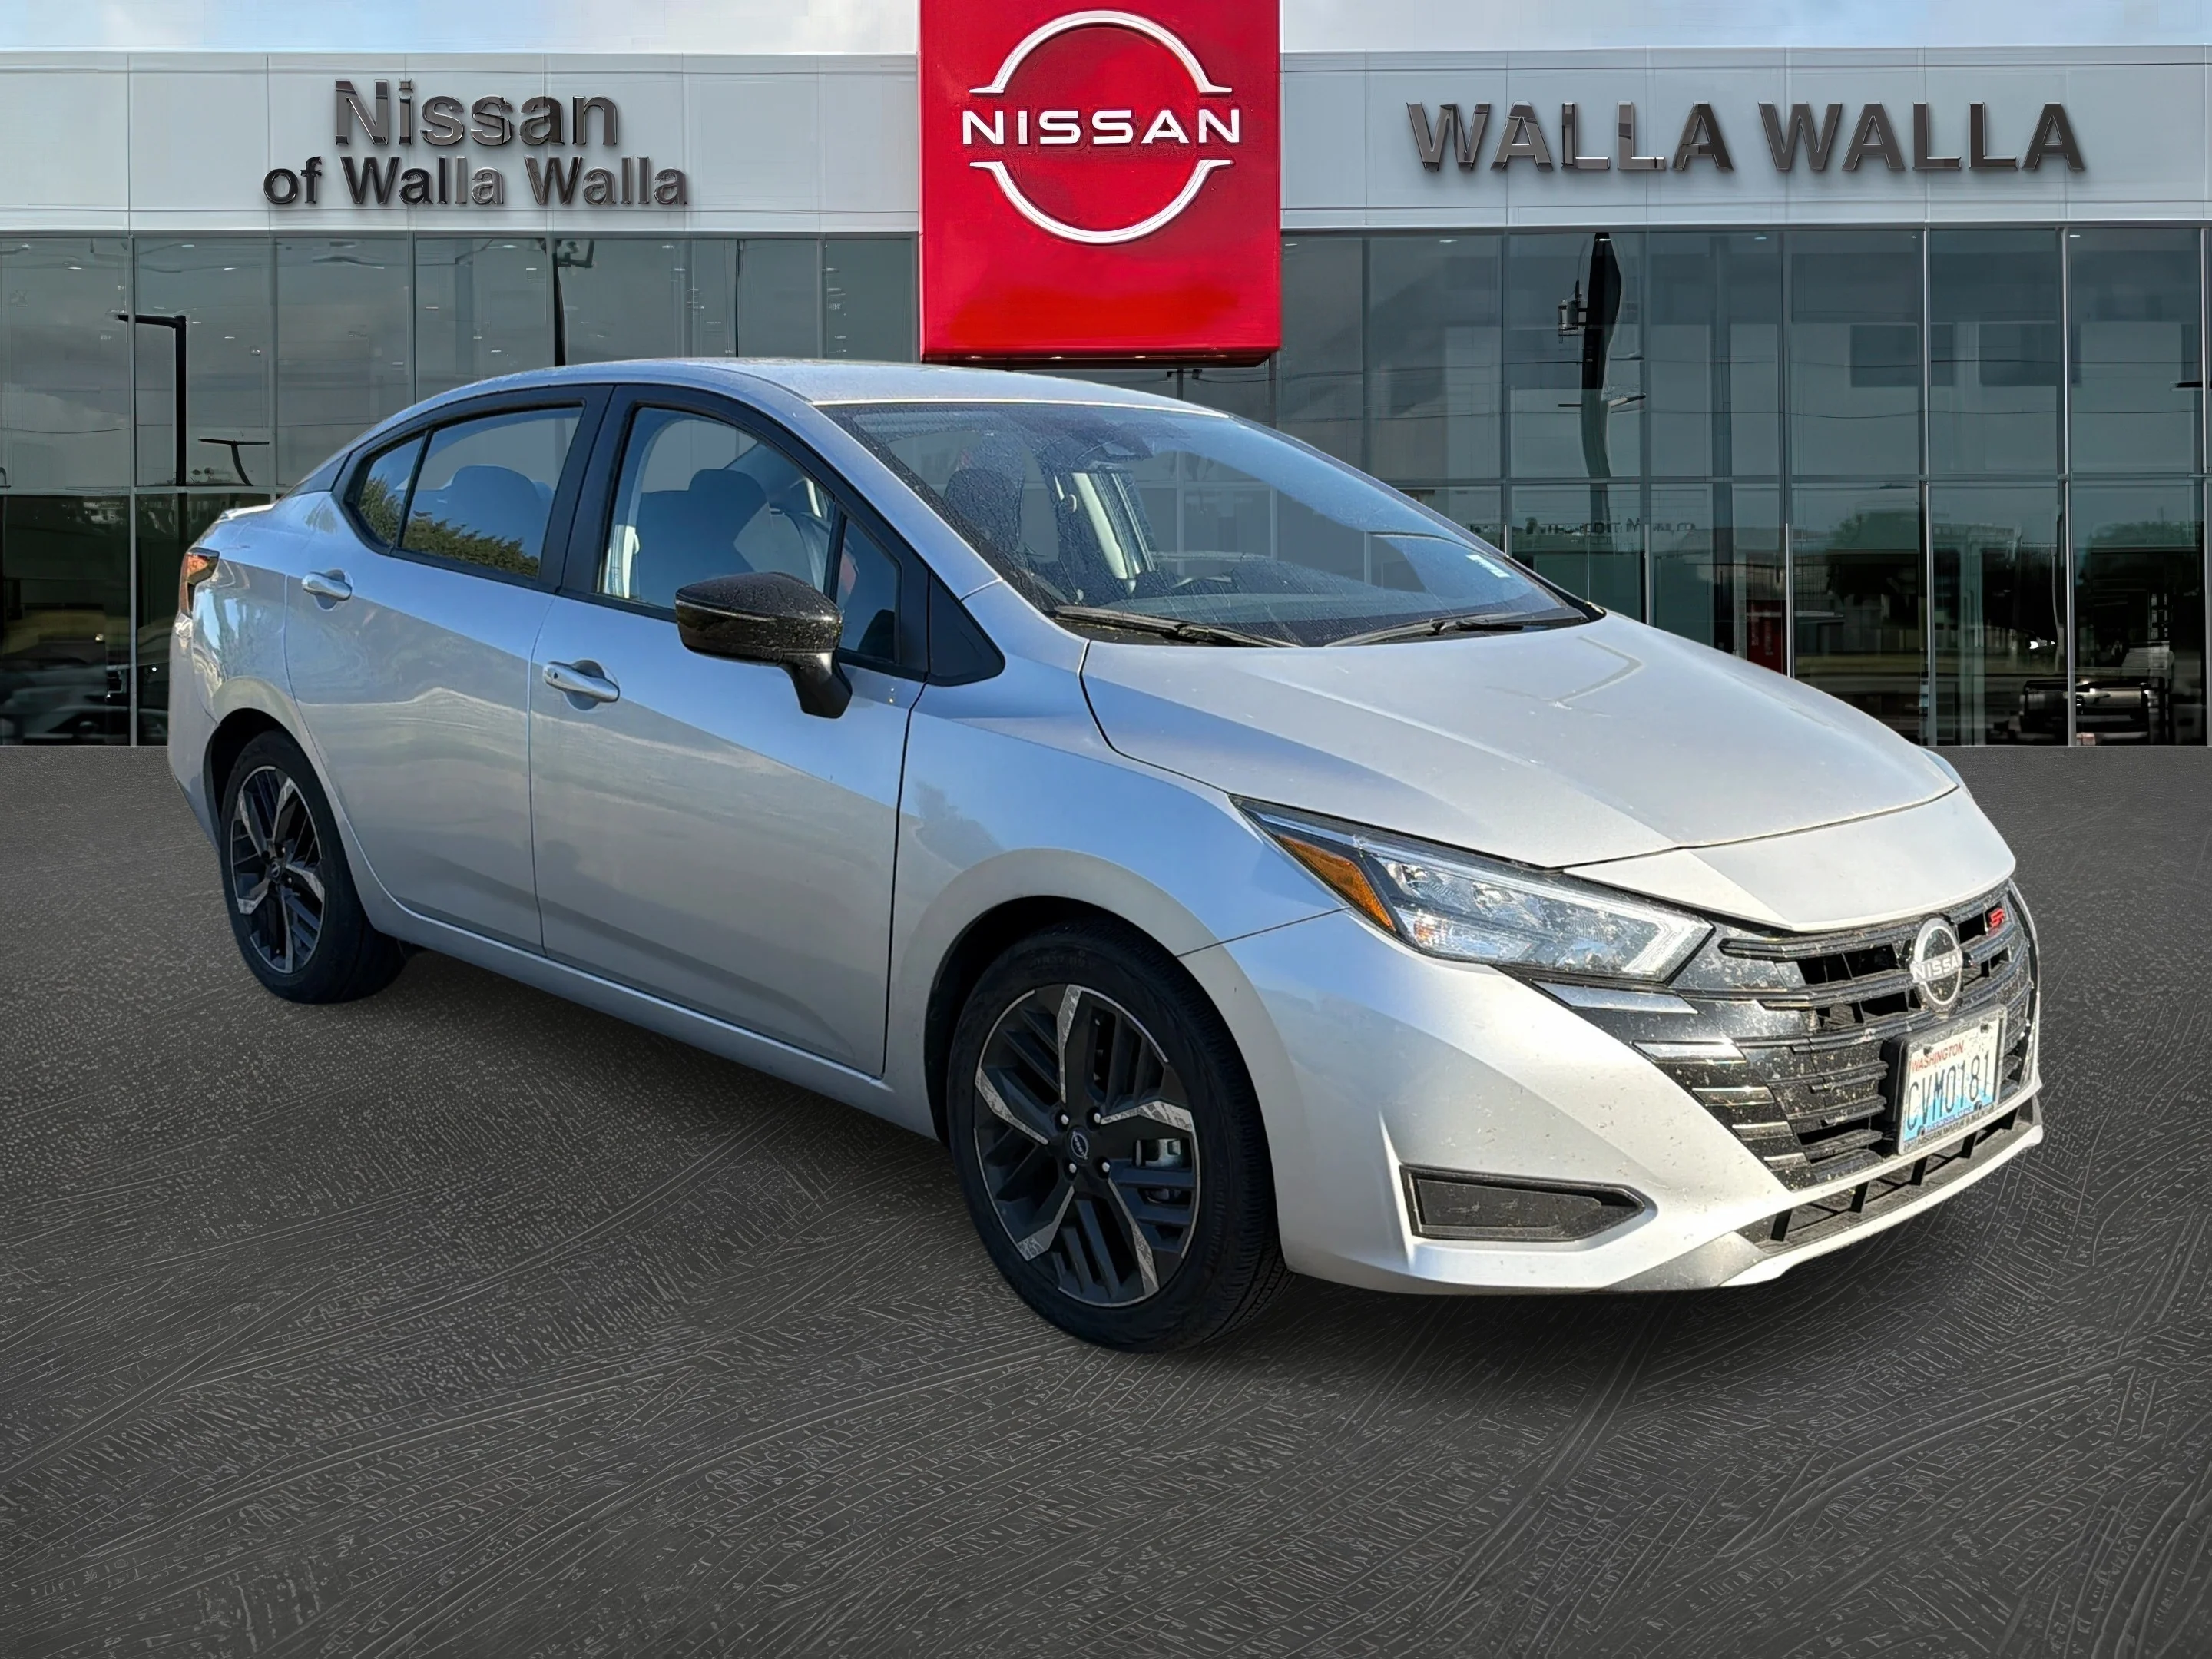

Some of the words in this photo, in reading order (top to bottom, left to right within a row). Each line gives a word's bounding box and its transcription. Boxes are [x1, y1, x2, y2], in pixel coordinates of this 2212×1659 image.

[334, 78, 618, 146] Nissan
[962, 109, 1240, 145] NISSAN
[1406, 100, 1734, 172] WALLA
[1758, 100, 2087, 172] WALLA
[263, 156, 323, 205] of
[339, 156, 505, 205] Walla
[523, 155, 688, 205] Walla
[1912, 954, 1962, 982] NISSA
[1911, 1040, 1965, 1073] WASHINGTON
